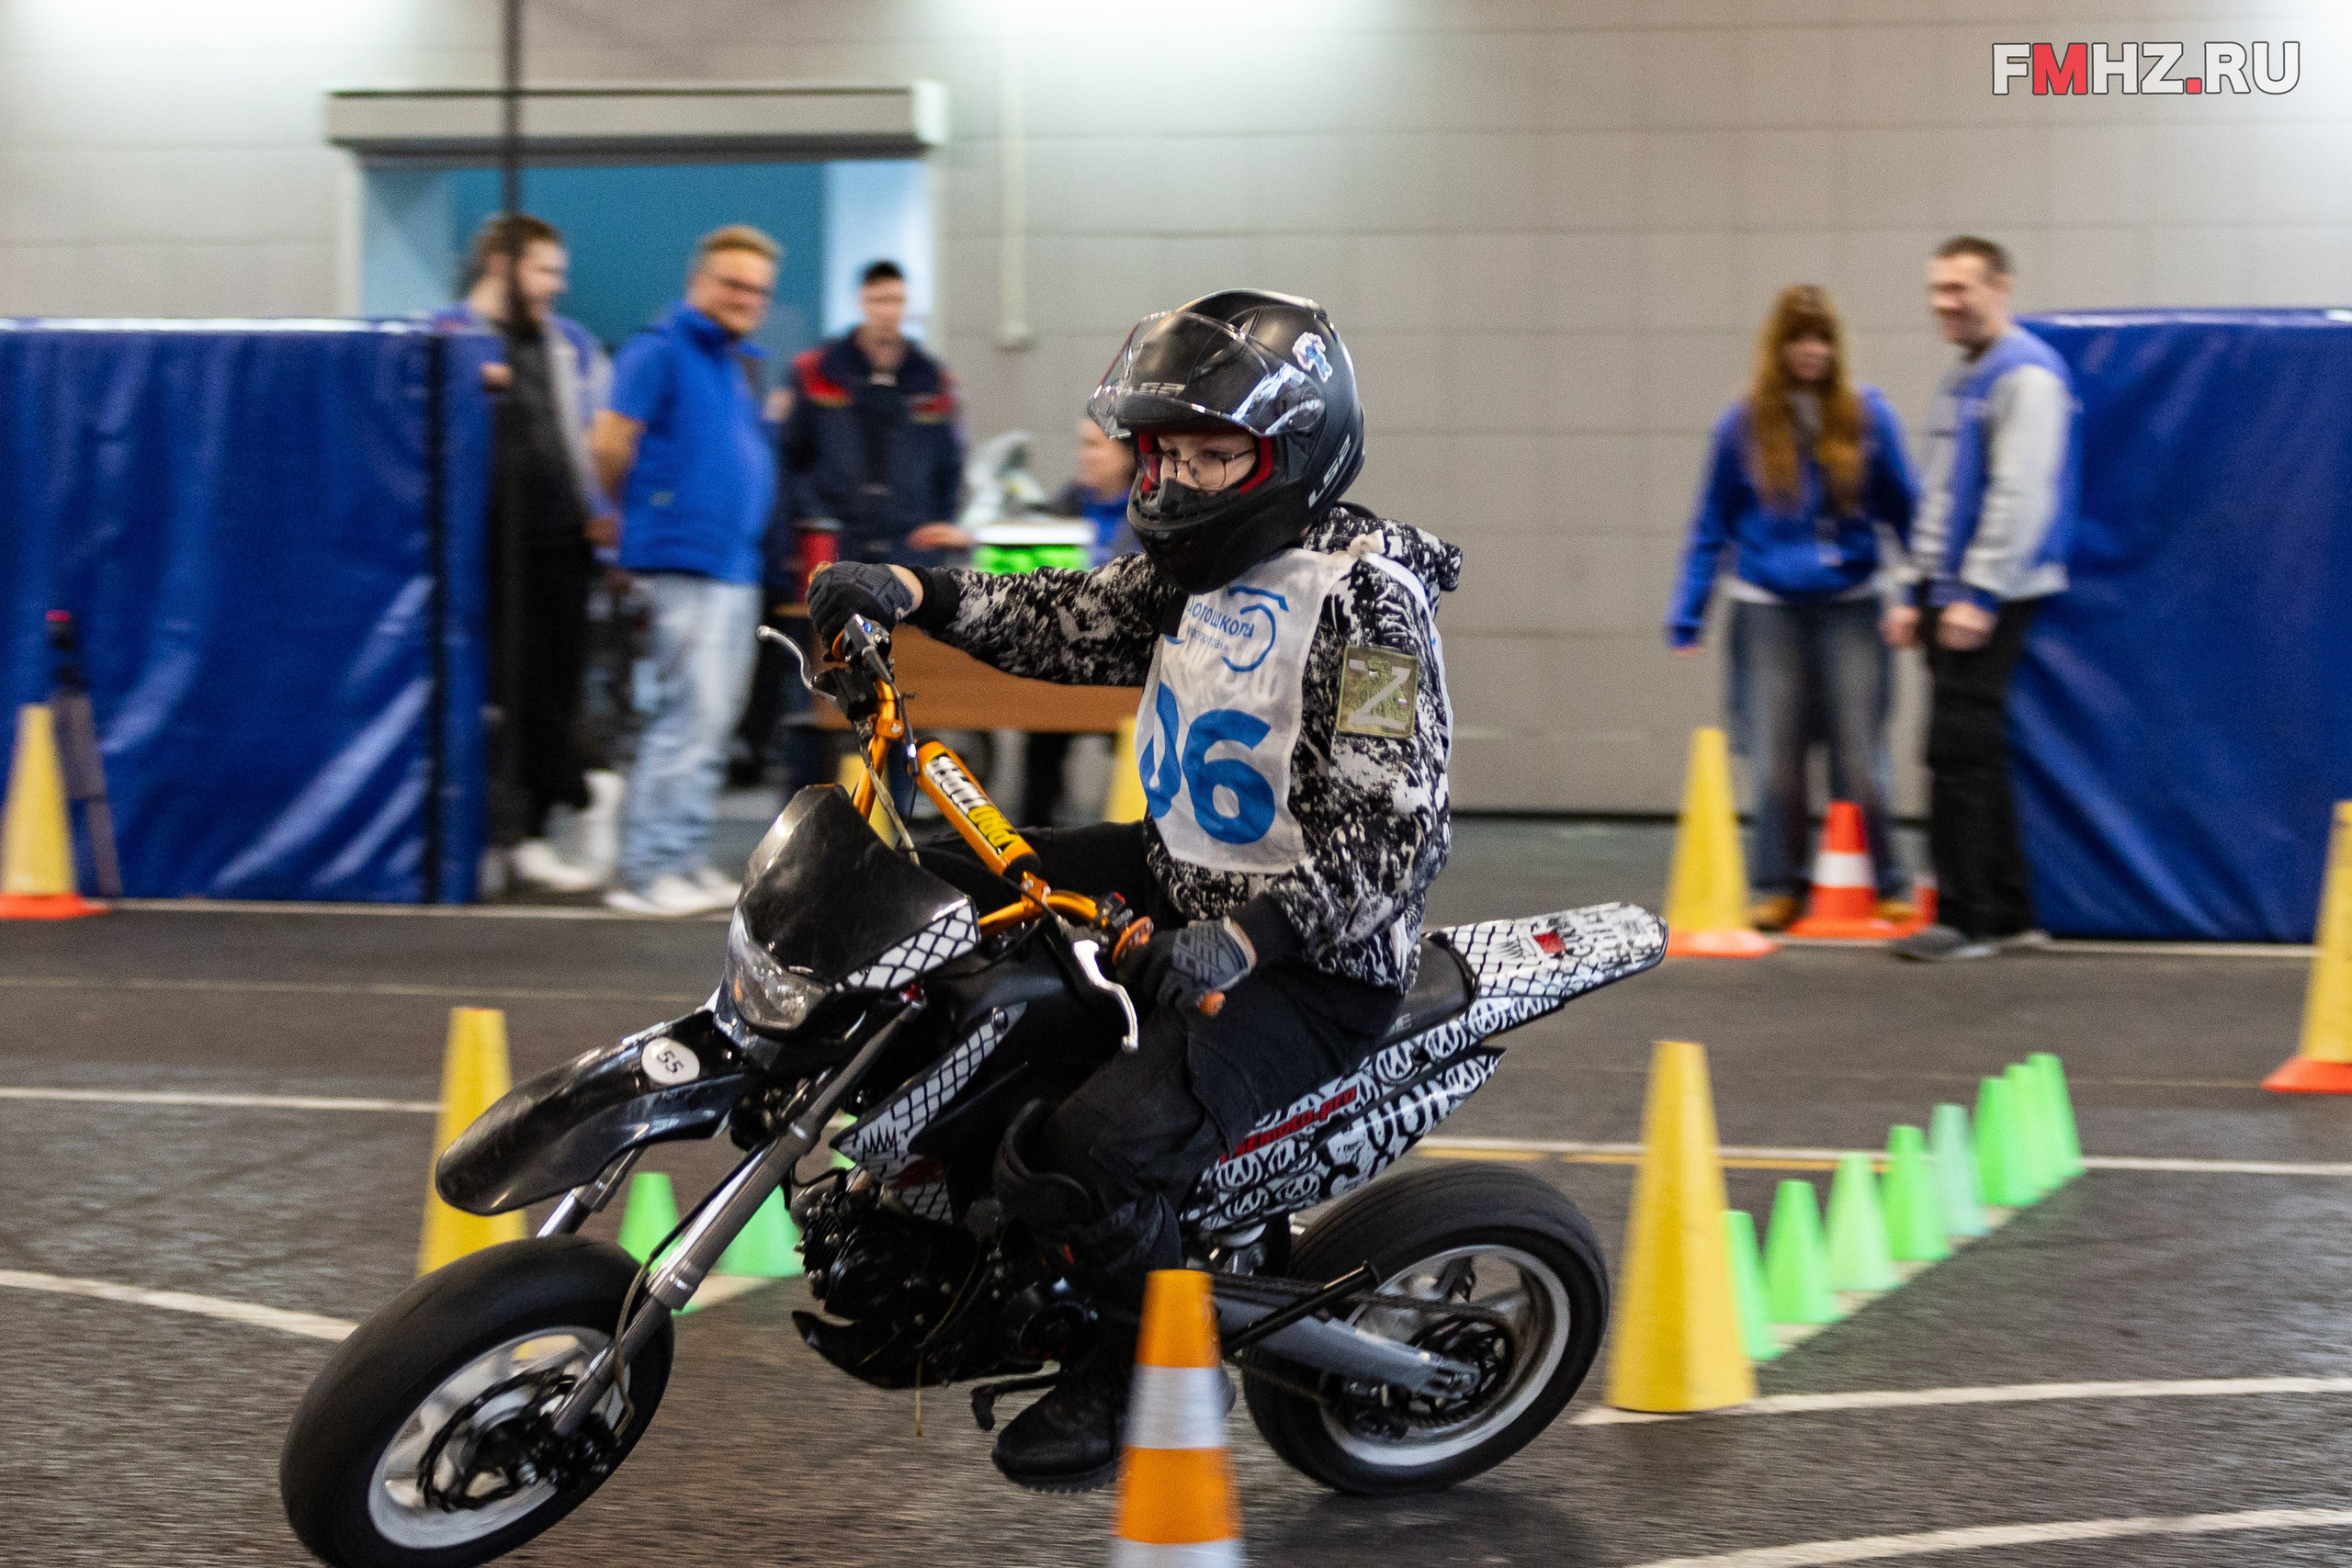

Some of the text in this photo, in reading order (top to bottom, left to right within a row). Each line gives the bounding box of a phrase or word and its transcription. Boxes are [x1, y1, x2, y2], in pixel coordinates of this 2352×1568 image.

[1308, 433, 1351, 509] LS2
[1138, 681, 1276, 844] 06
[656, 1050, 684, 1073] 55
